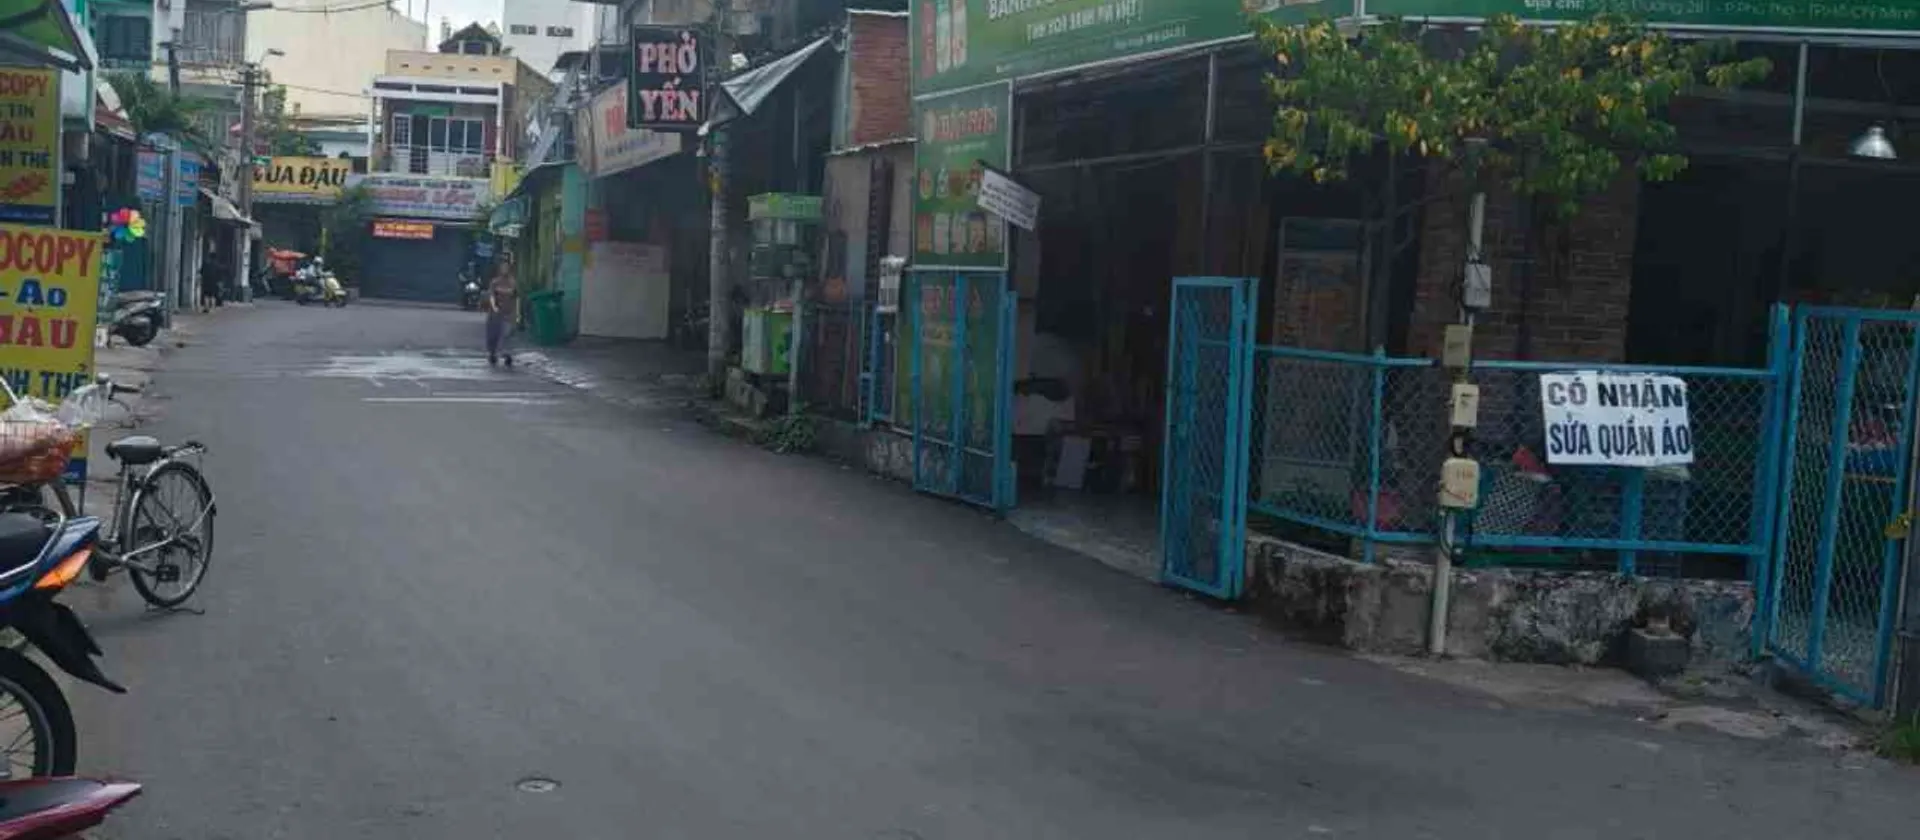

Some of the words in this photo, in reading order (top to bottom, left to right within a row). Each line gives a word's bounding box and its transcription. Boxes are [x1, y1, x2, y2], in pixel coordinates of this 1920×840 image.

[639, 31, 697, 73] PHỞ
[639, 77, 700, 121] YẾN
[299, 161, 349, 190] ĐẬU
[1547, 376, 1588, 406] CÓ
[1597, 378, 1683, 413] NHẬN
[1549, 411, 1592, 455] SỬA
[1662, 418, 1692, 455] ÁO
